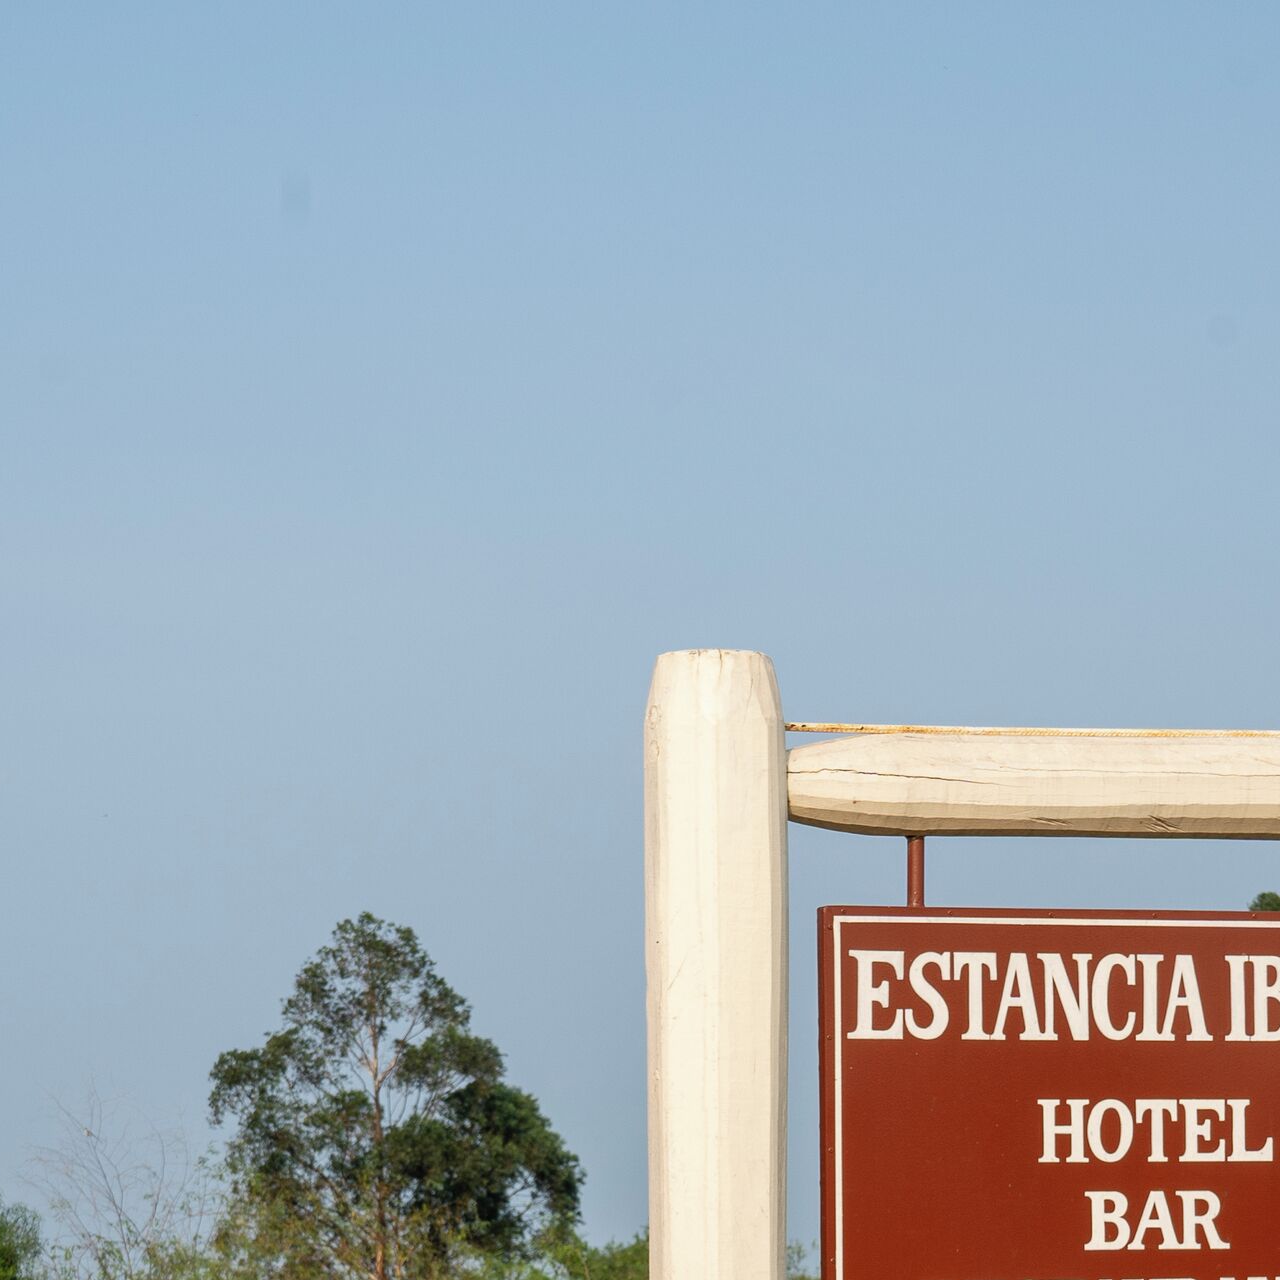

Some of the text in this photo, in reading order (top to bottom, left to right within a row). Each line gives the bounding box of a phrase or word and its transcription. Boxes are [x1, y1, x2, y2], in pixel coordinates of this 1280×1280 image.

[847, 950, 1213, 1041] ESTANCIA
[1037, 1099, 1273, 1163] HOTEL
[1084, 1190, 1230, 1251] BAR
